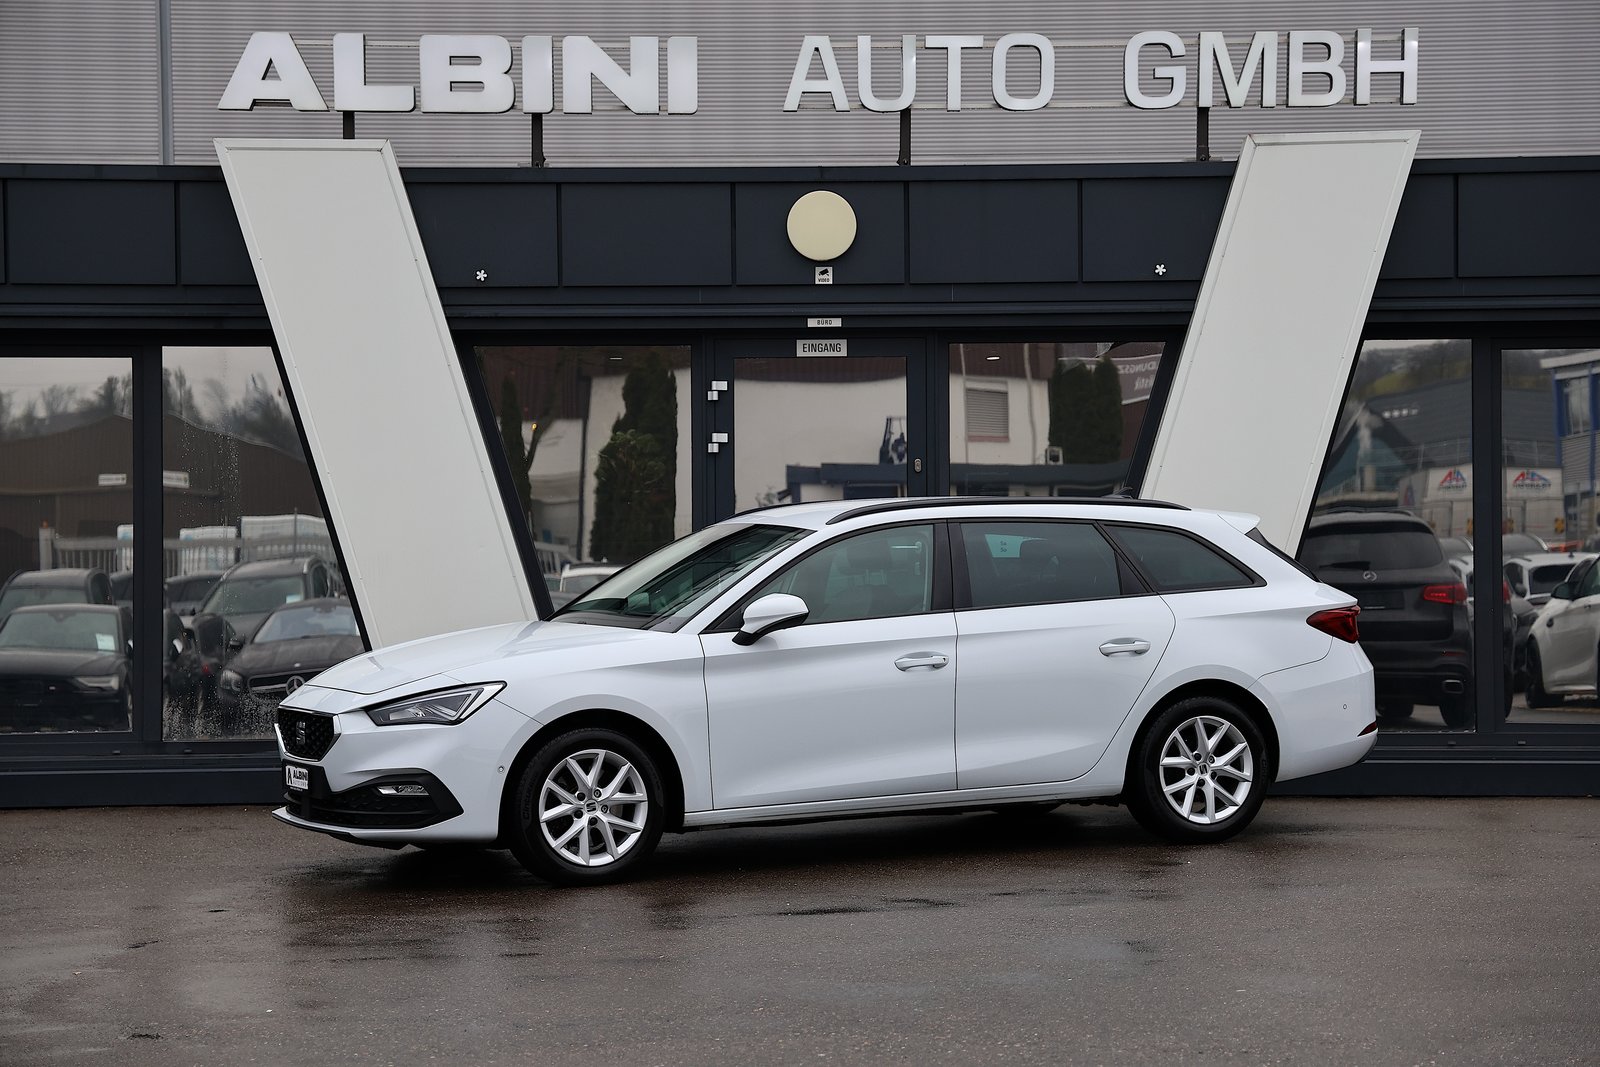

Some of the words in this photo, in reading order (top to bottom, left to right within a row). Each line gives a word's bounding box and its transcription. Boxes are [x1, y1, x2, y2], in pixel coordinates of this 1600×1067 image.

[217, 31, 698, 114] ALBINI
[783, 33, 1055, 112] AUTO
[1123, 27, 1419, 109] GMBH
[802, 342, 842, 353] EINGANG
